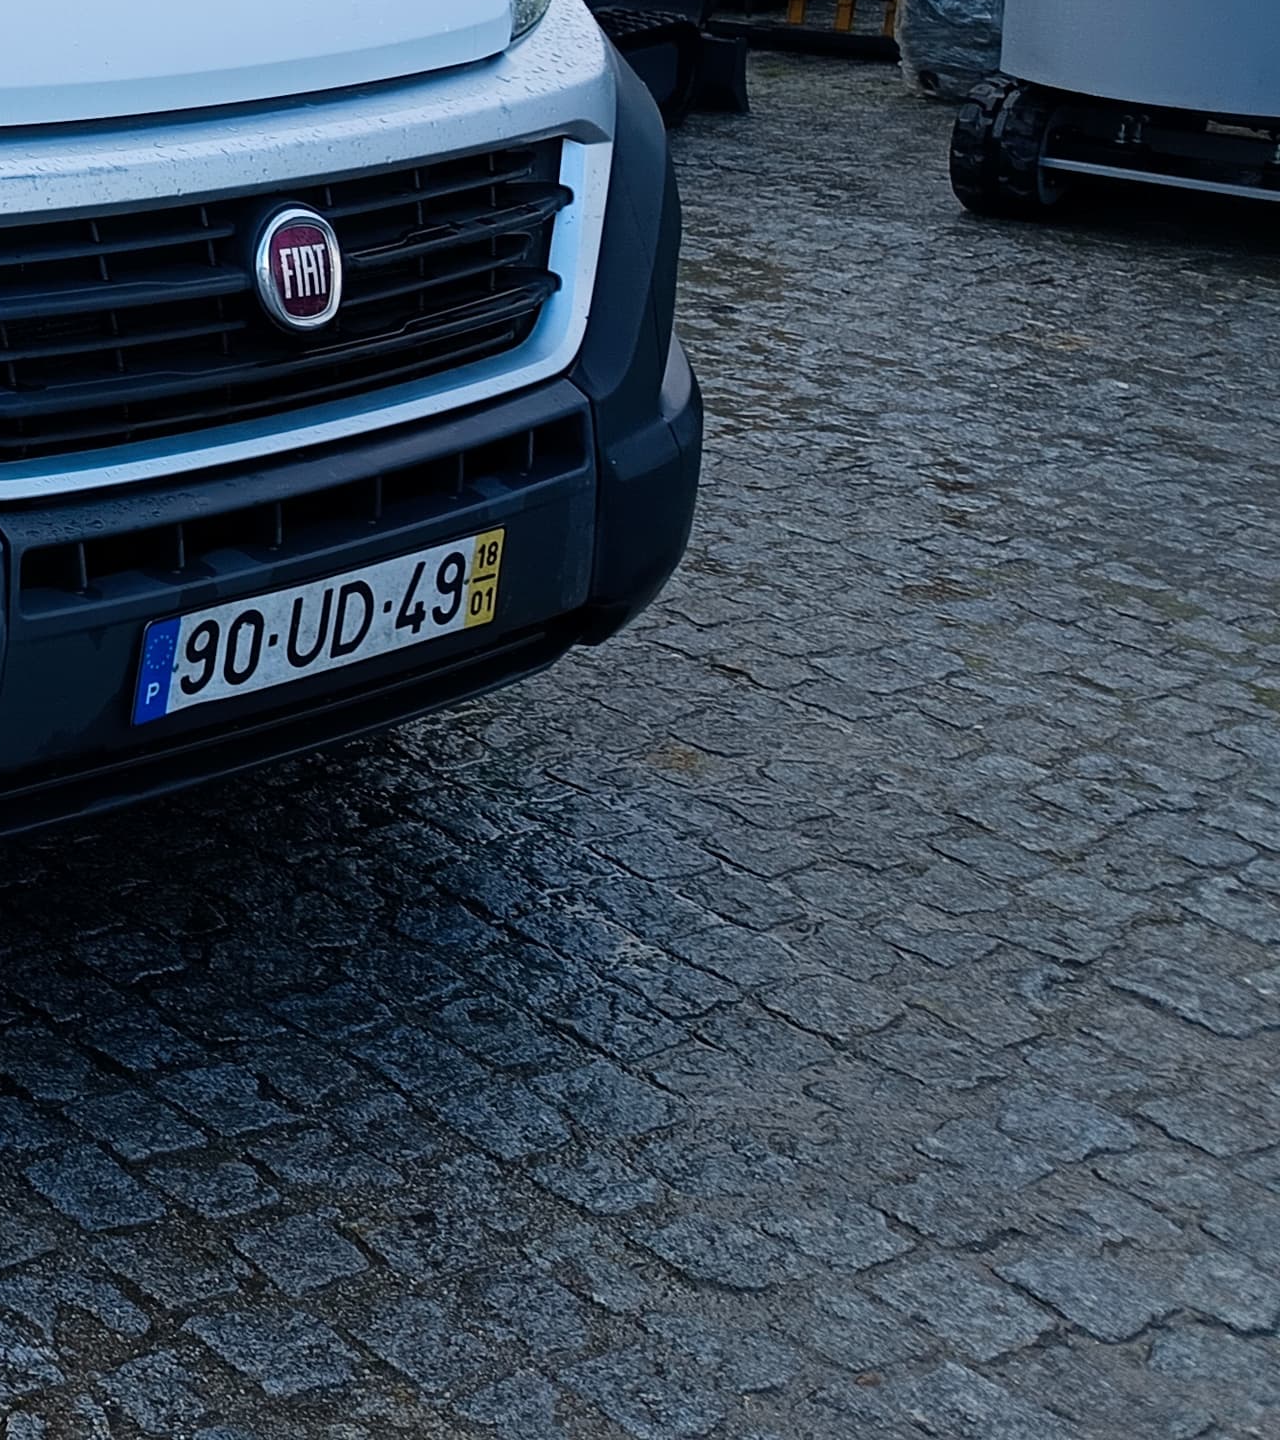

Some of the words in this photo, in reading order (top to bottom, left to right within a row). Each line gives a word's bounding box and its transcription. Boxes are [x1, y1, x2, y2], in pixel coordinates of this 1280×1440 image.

[279, 243, 327, 299] FIAT
[477, 541, 498, 570] 18
[469, 587, 494, 616] 01
[145, 682, 159, 705] P
